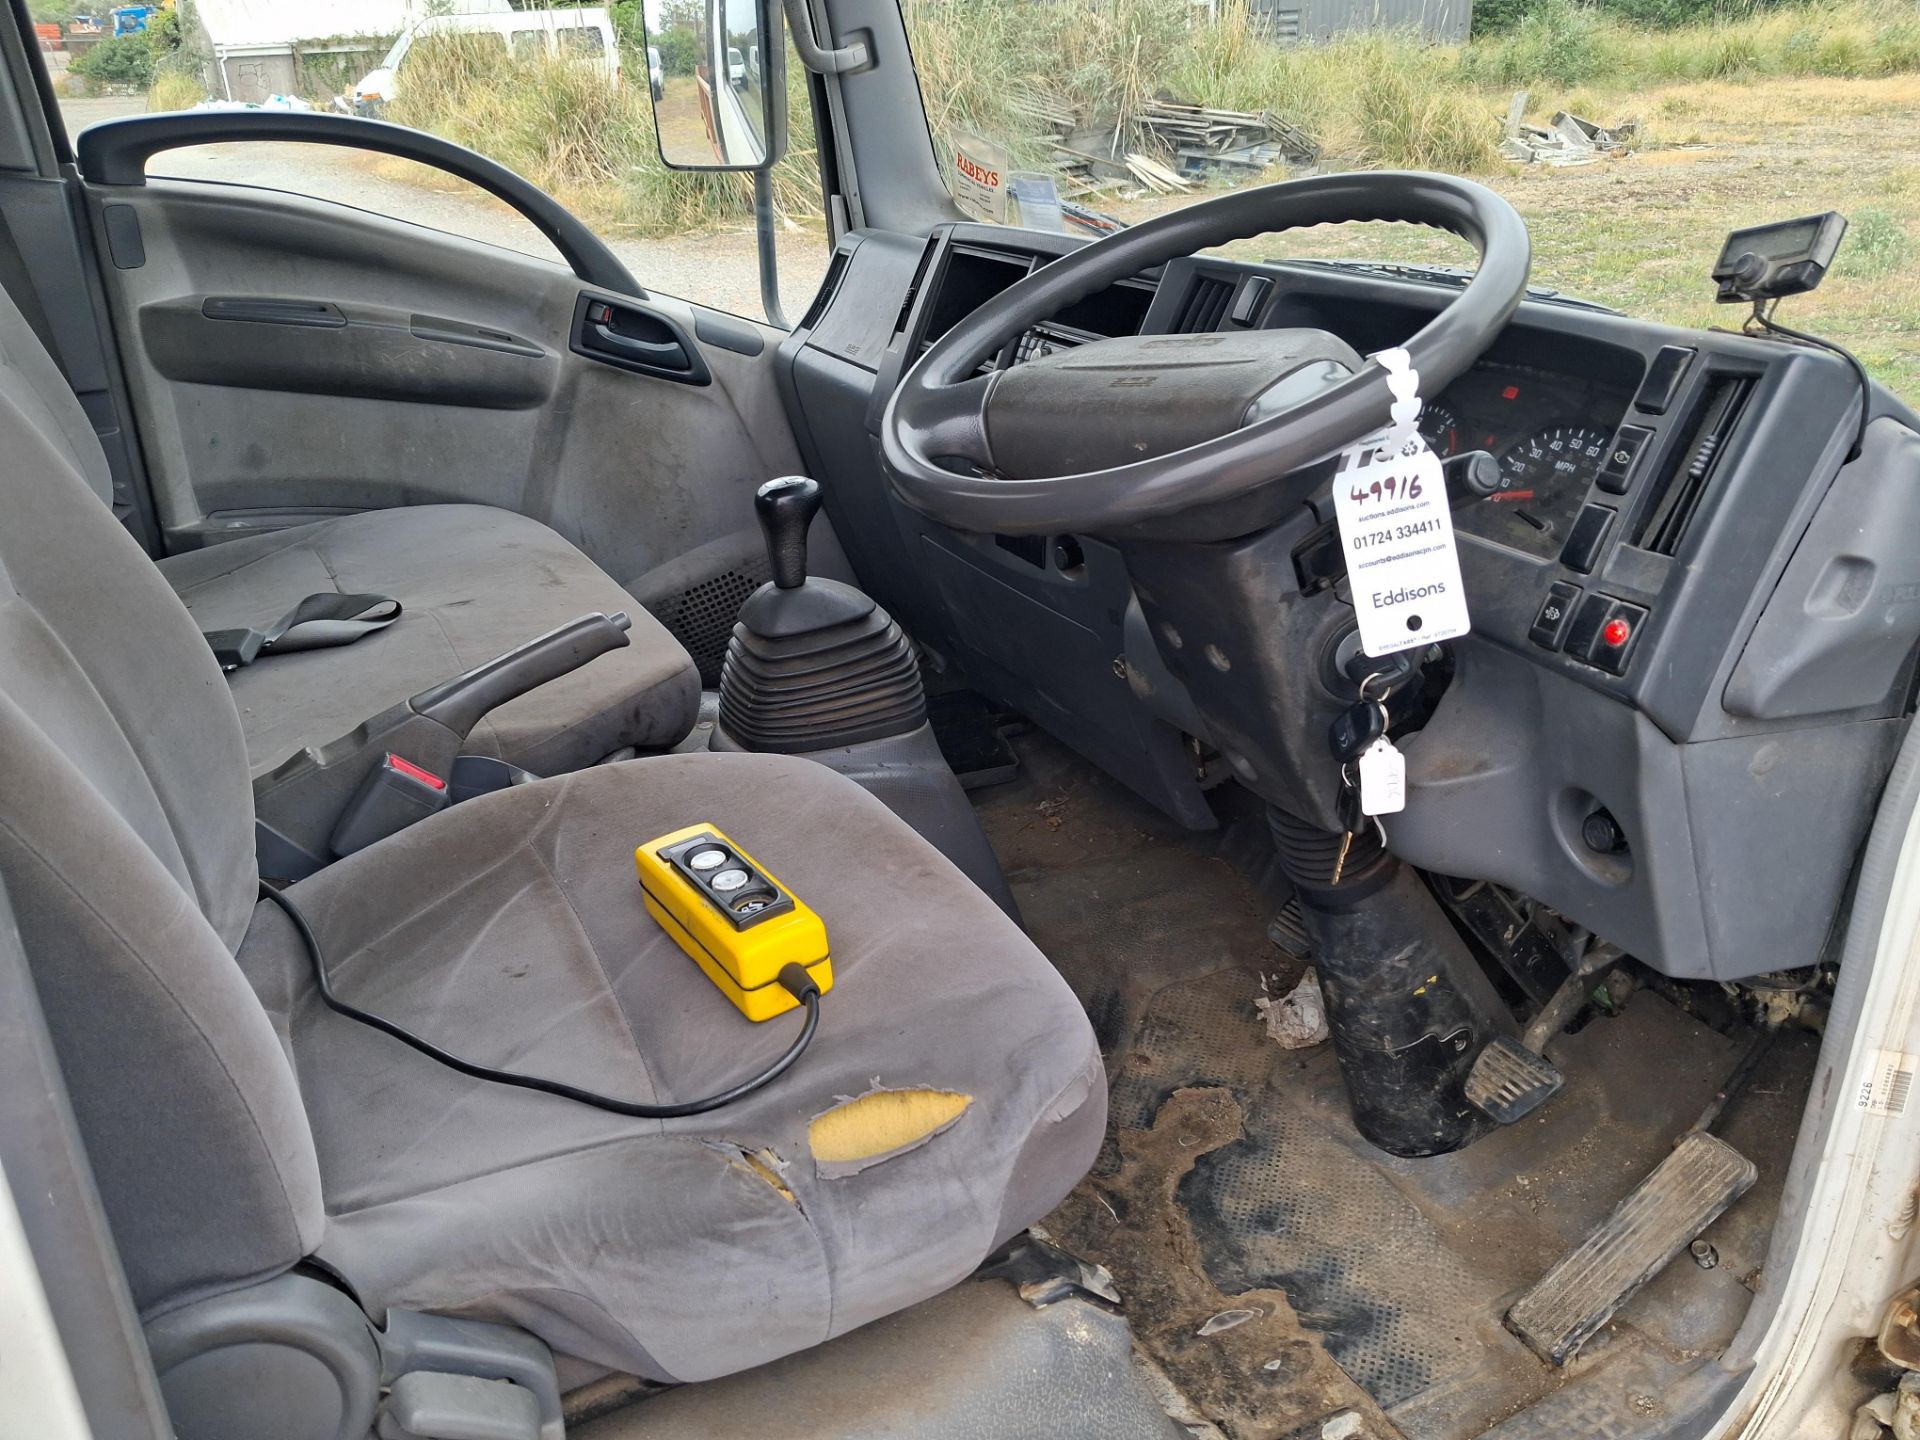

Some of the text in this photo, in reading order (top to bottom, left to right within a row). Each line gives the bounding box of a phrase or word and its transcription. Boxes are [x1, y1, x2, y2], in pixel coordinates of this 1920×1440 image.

[957, 152, 998, 186] RABEYS
[1549, 439, 1562, 452] 40
[1570, 437, 1582, 449] 50
[1530, 448, 1542, 459] 30
[1586, 445, 1599, 457] 60
[1512, 461, 1525, 472] 20
[1555, 461, 1576, 473] MPH
[1359, 501, 1430, 522] auctions.eddisons.com
[1353, 518, 1442, 550] 01724 334411
[1373, 580, 1447, 609] Eddisons
[1858, 1082, 1873, 1107] 9226
